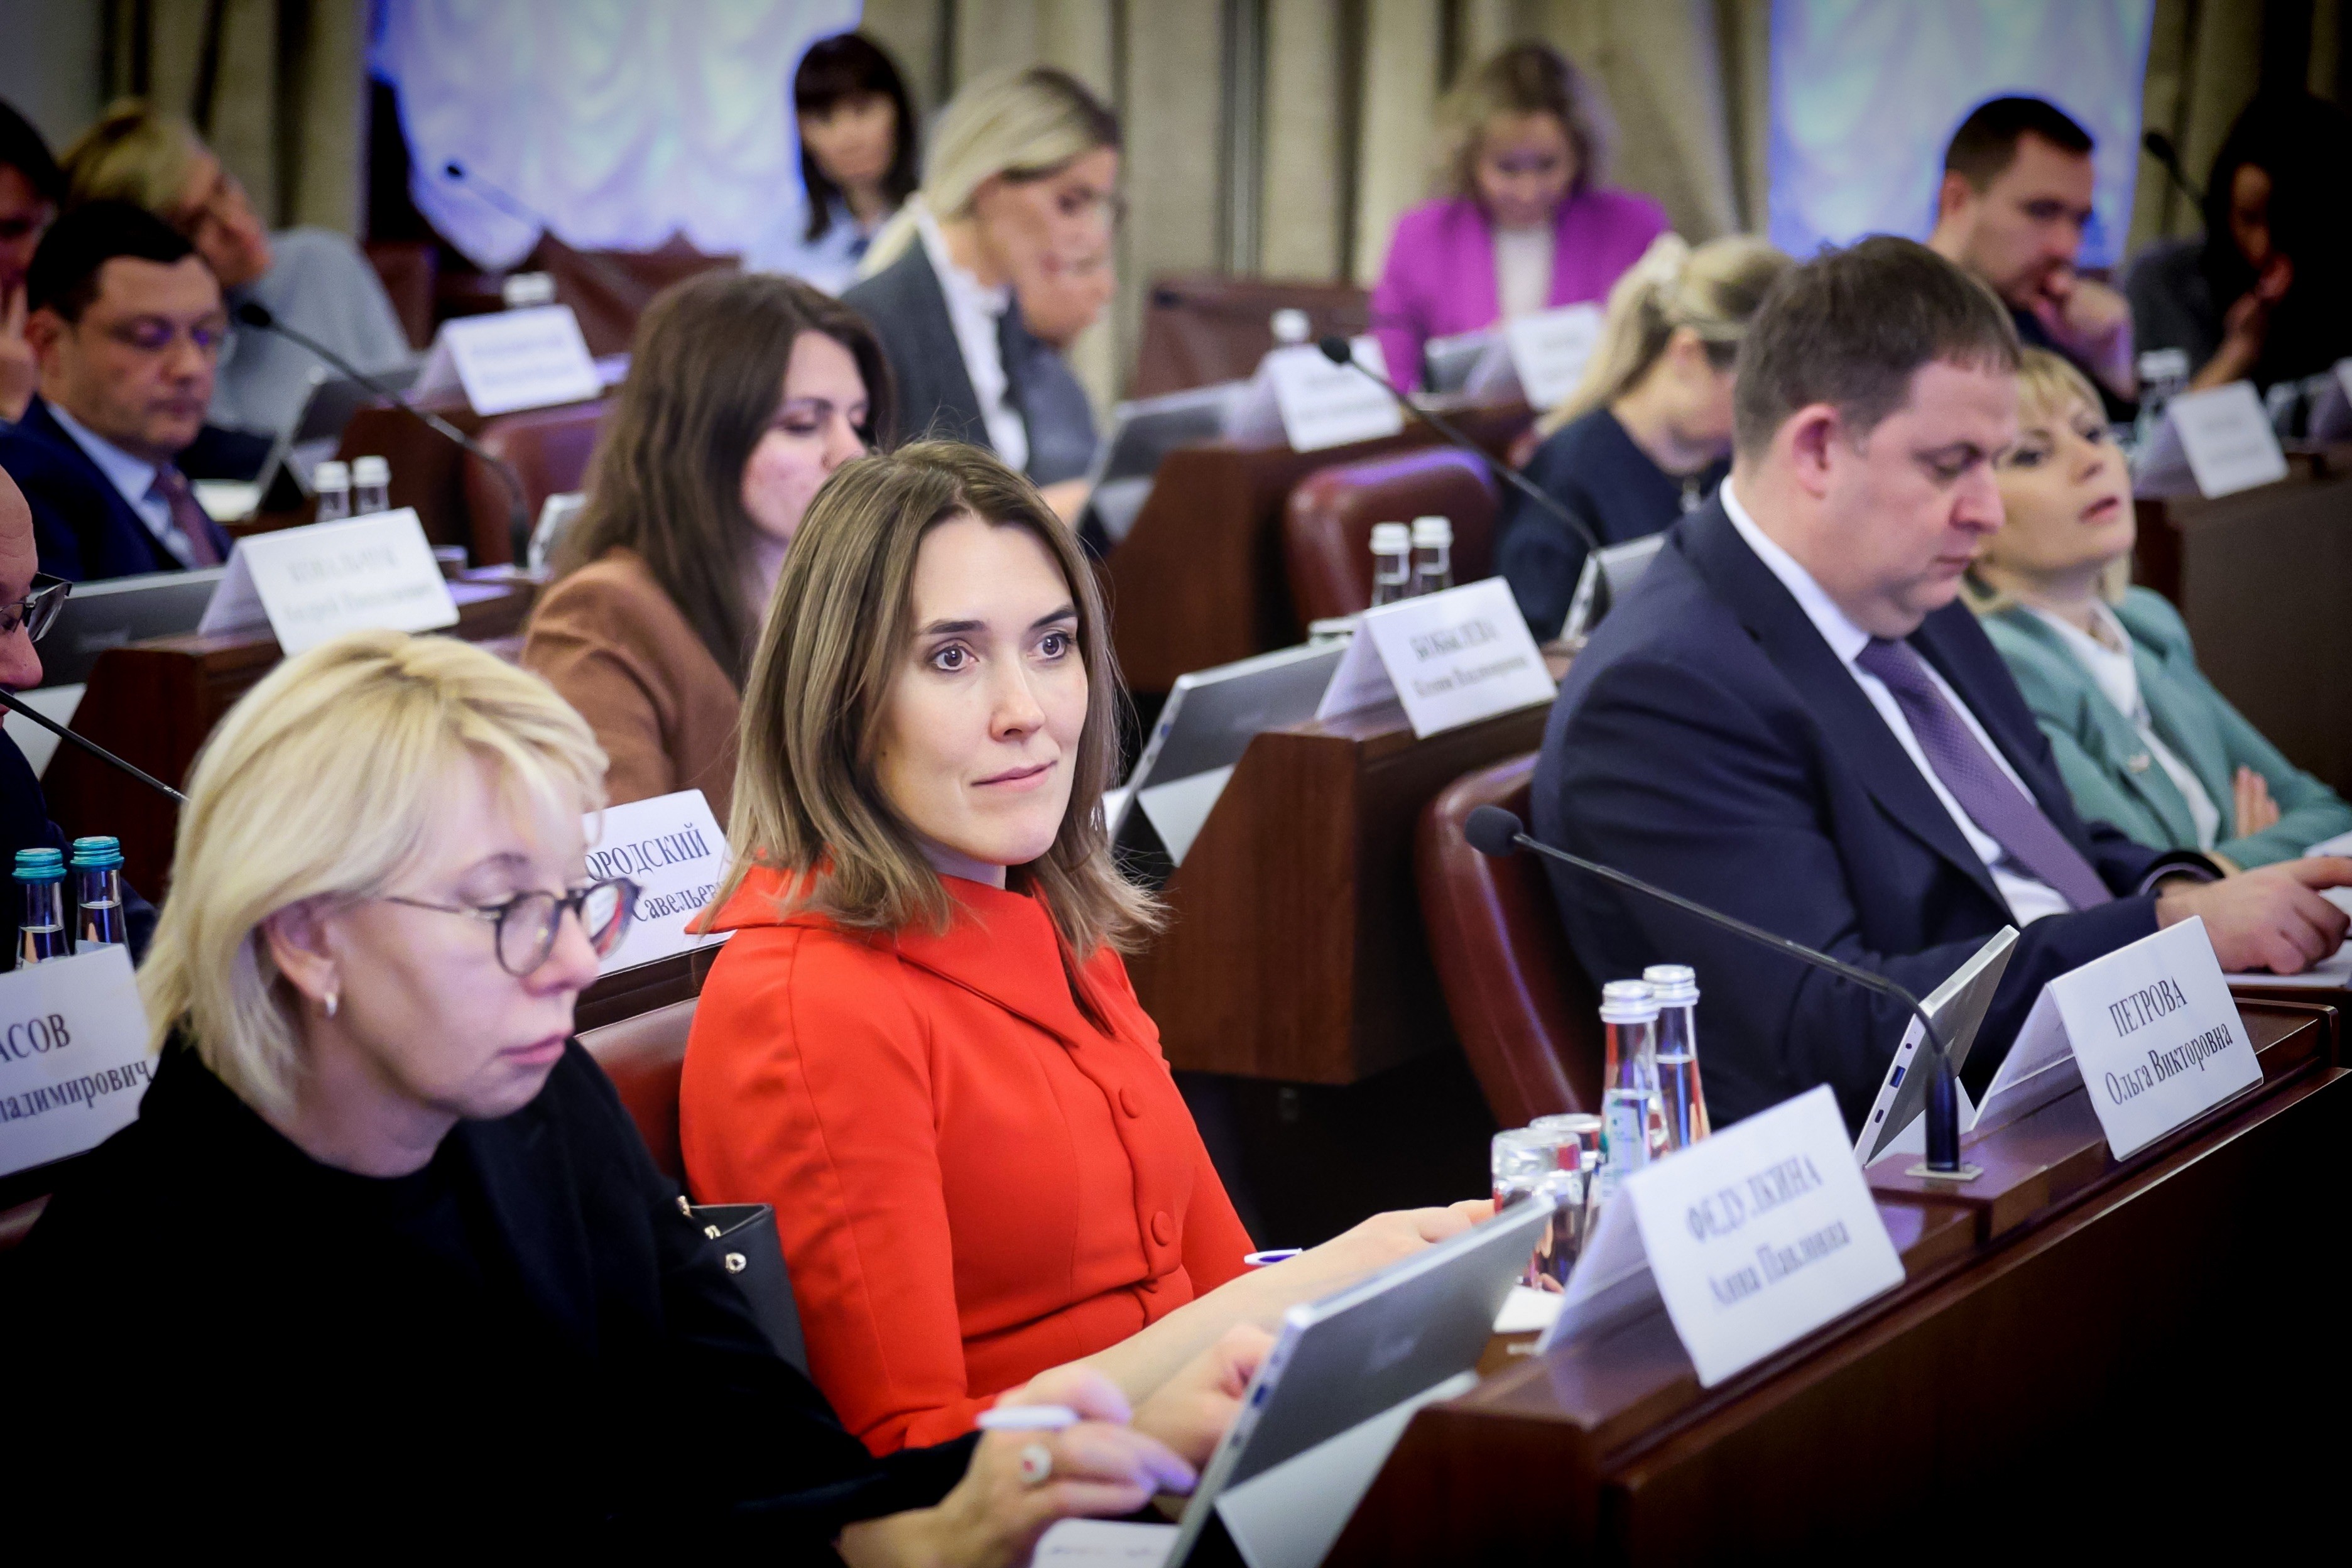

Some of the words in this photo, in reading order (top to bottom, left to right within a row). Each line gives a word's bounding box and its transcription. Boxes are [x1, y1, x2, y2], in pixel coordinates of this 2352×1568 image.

[632, 880, 721, 922] Савельев
[2108, 976, 2188, 1038] ПЕТРОВА
[2104, 1064, 2154, 1106] Ольга
[2147, 1023, 2234, 1083] Викторовна
